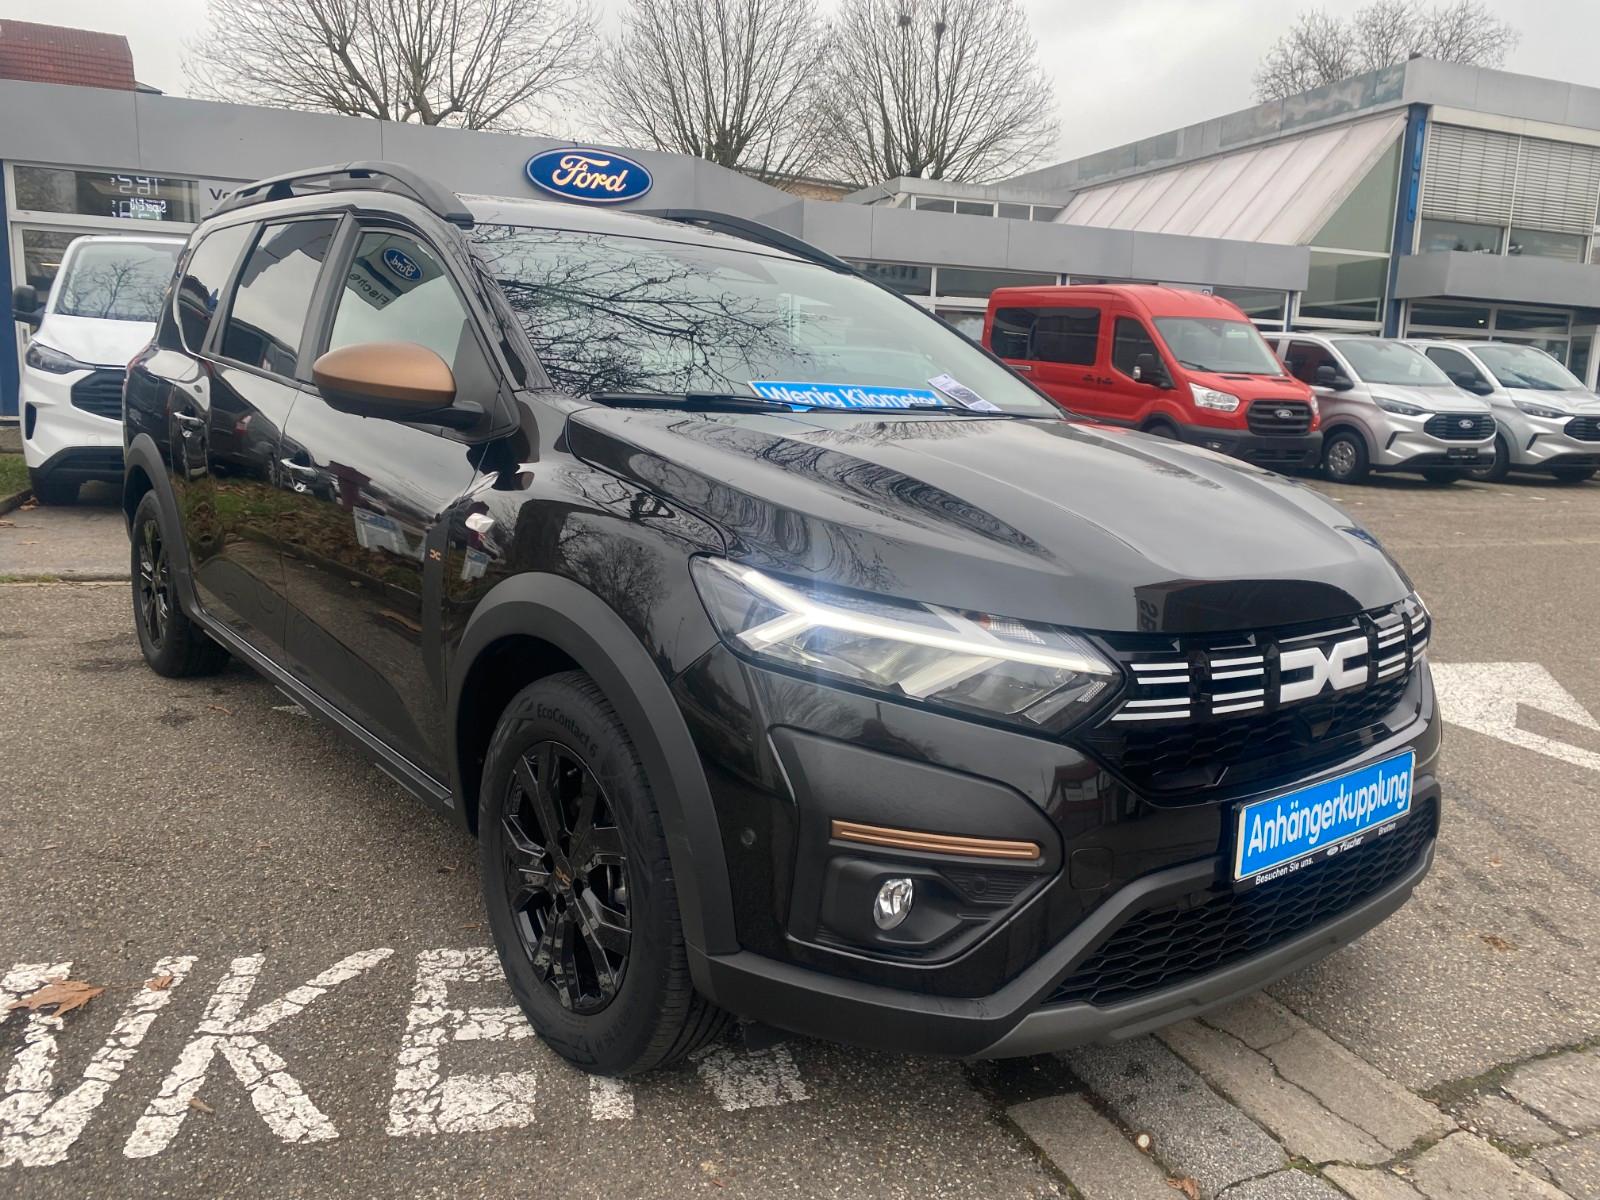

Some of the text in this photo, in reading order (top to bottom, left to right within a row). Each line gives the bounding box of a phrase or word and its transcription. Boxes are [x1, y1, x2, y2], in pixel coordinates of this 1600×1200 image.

[551, 154, 628, 192] Ford
[760, 386, 843, 407] Wenig
[536, 703, 590, 749] EcoContact
[1247, 770, 1408, 857] Anhängerkupplung
[1255, 867, 1288, 885] Besuchen
[1289, 860, 1299, 872] Sie
